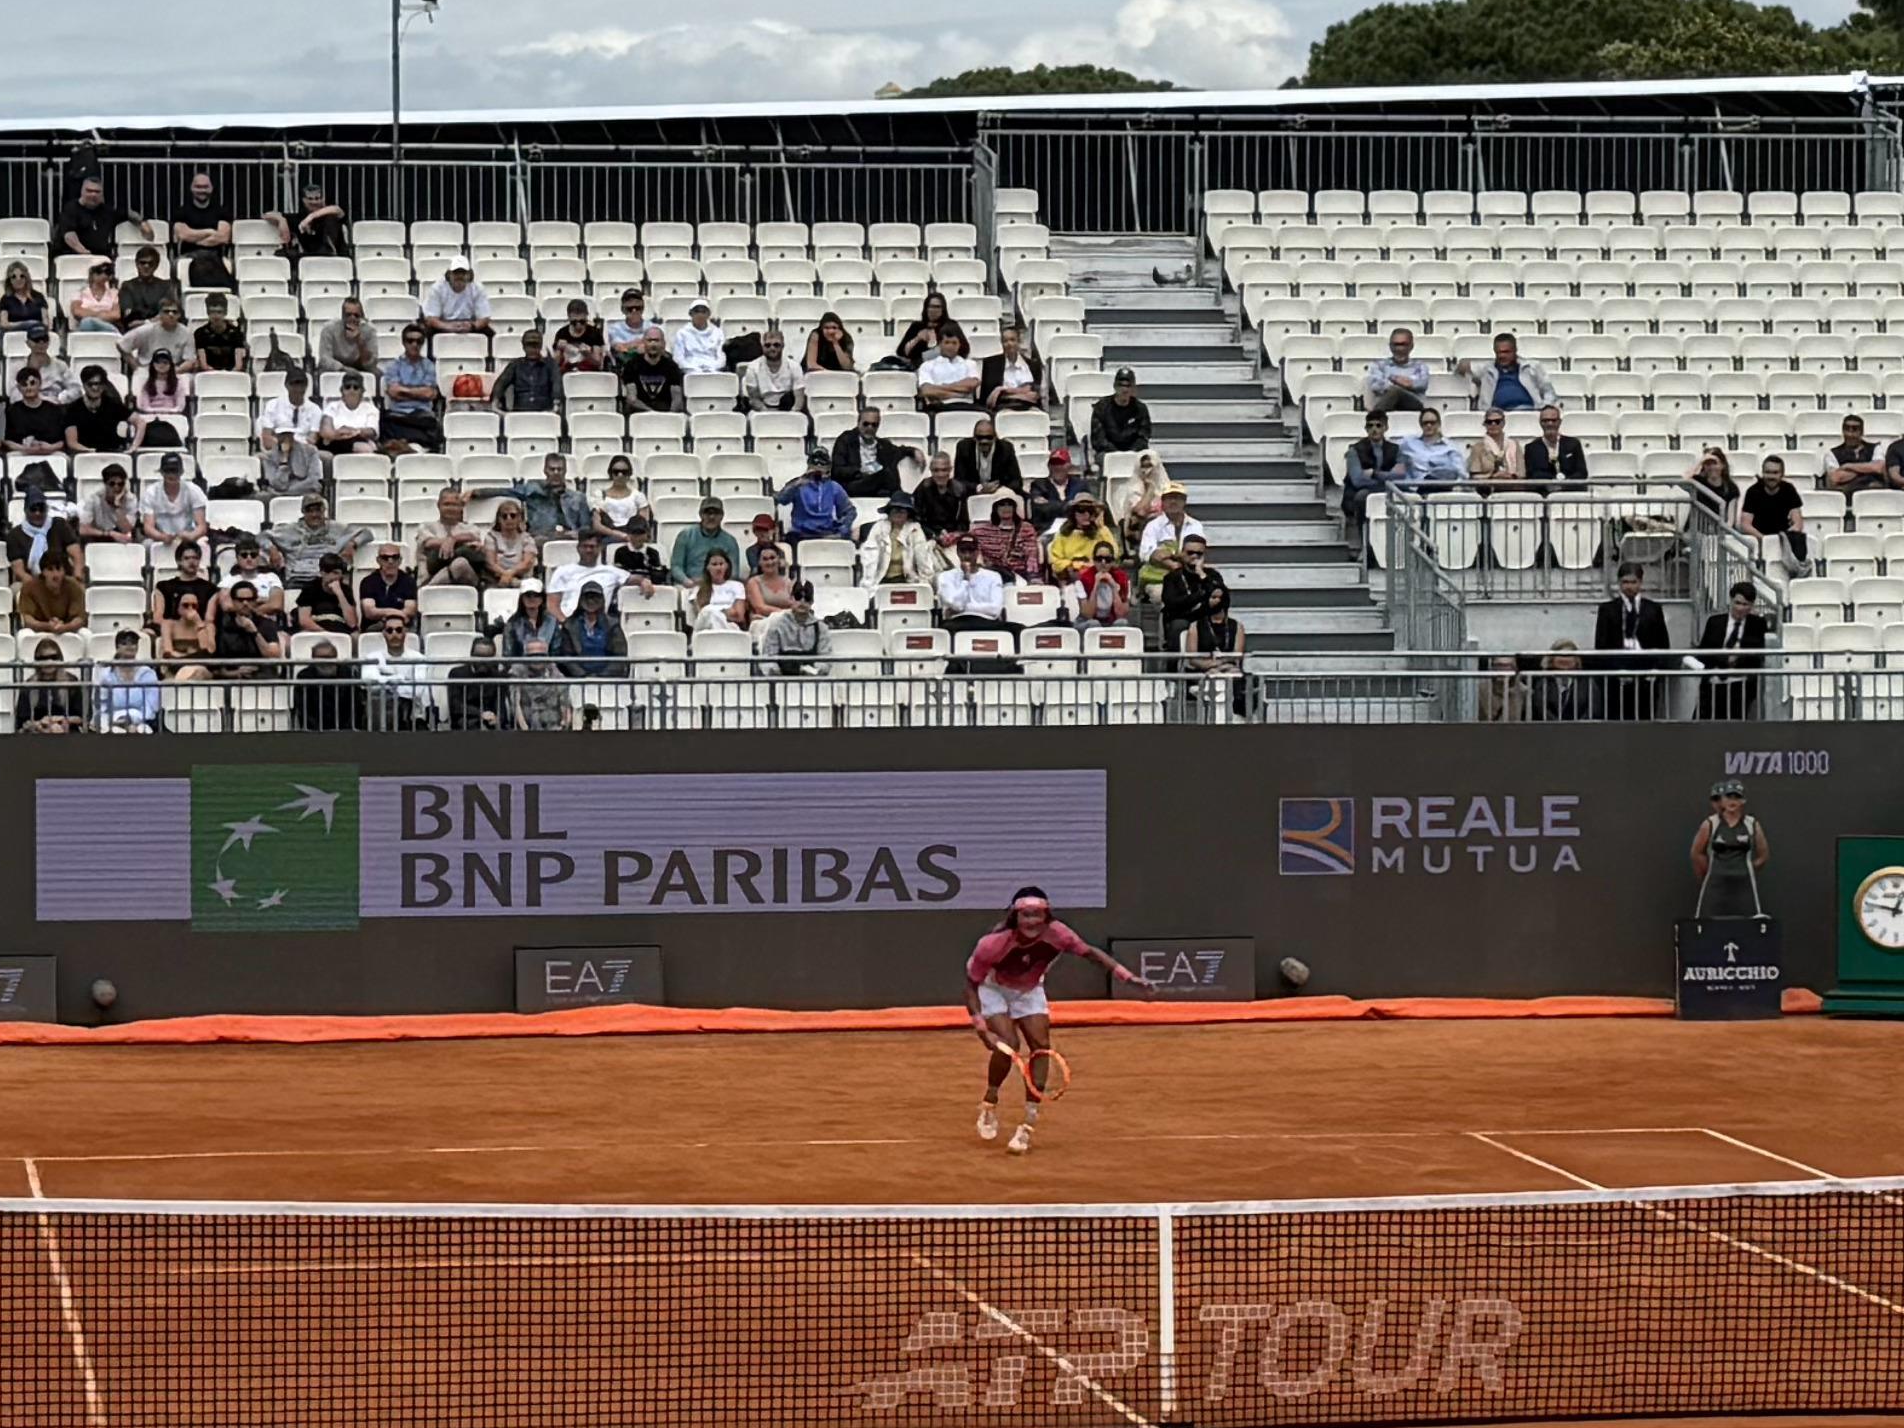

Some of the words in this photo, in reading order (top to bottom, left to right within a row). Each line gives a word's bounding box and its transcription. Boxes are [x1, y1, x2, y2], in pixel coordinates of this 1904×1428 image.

[1725, 752, 1783, 774] WTA
[1787, 751, 1829, 774] 1000
[400, 784, 567, 840] BNL
[1372, 796, 1580, 838] REALE
[1372, 847, 1580, 872] MUTUA
[400, 851, 575, 908] BNP
[603, 845, 961, 906] PARIBAS
[546, 960, 632, 993] EA7
[1141, 951, 1224, 984] EA7
[1684, 966, 1779, 981] AURICCHIO
[853, 1308, 1150, 1409] ATP
[1199, 1299, 1523, 1400] TOUR
